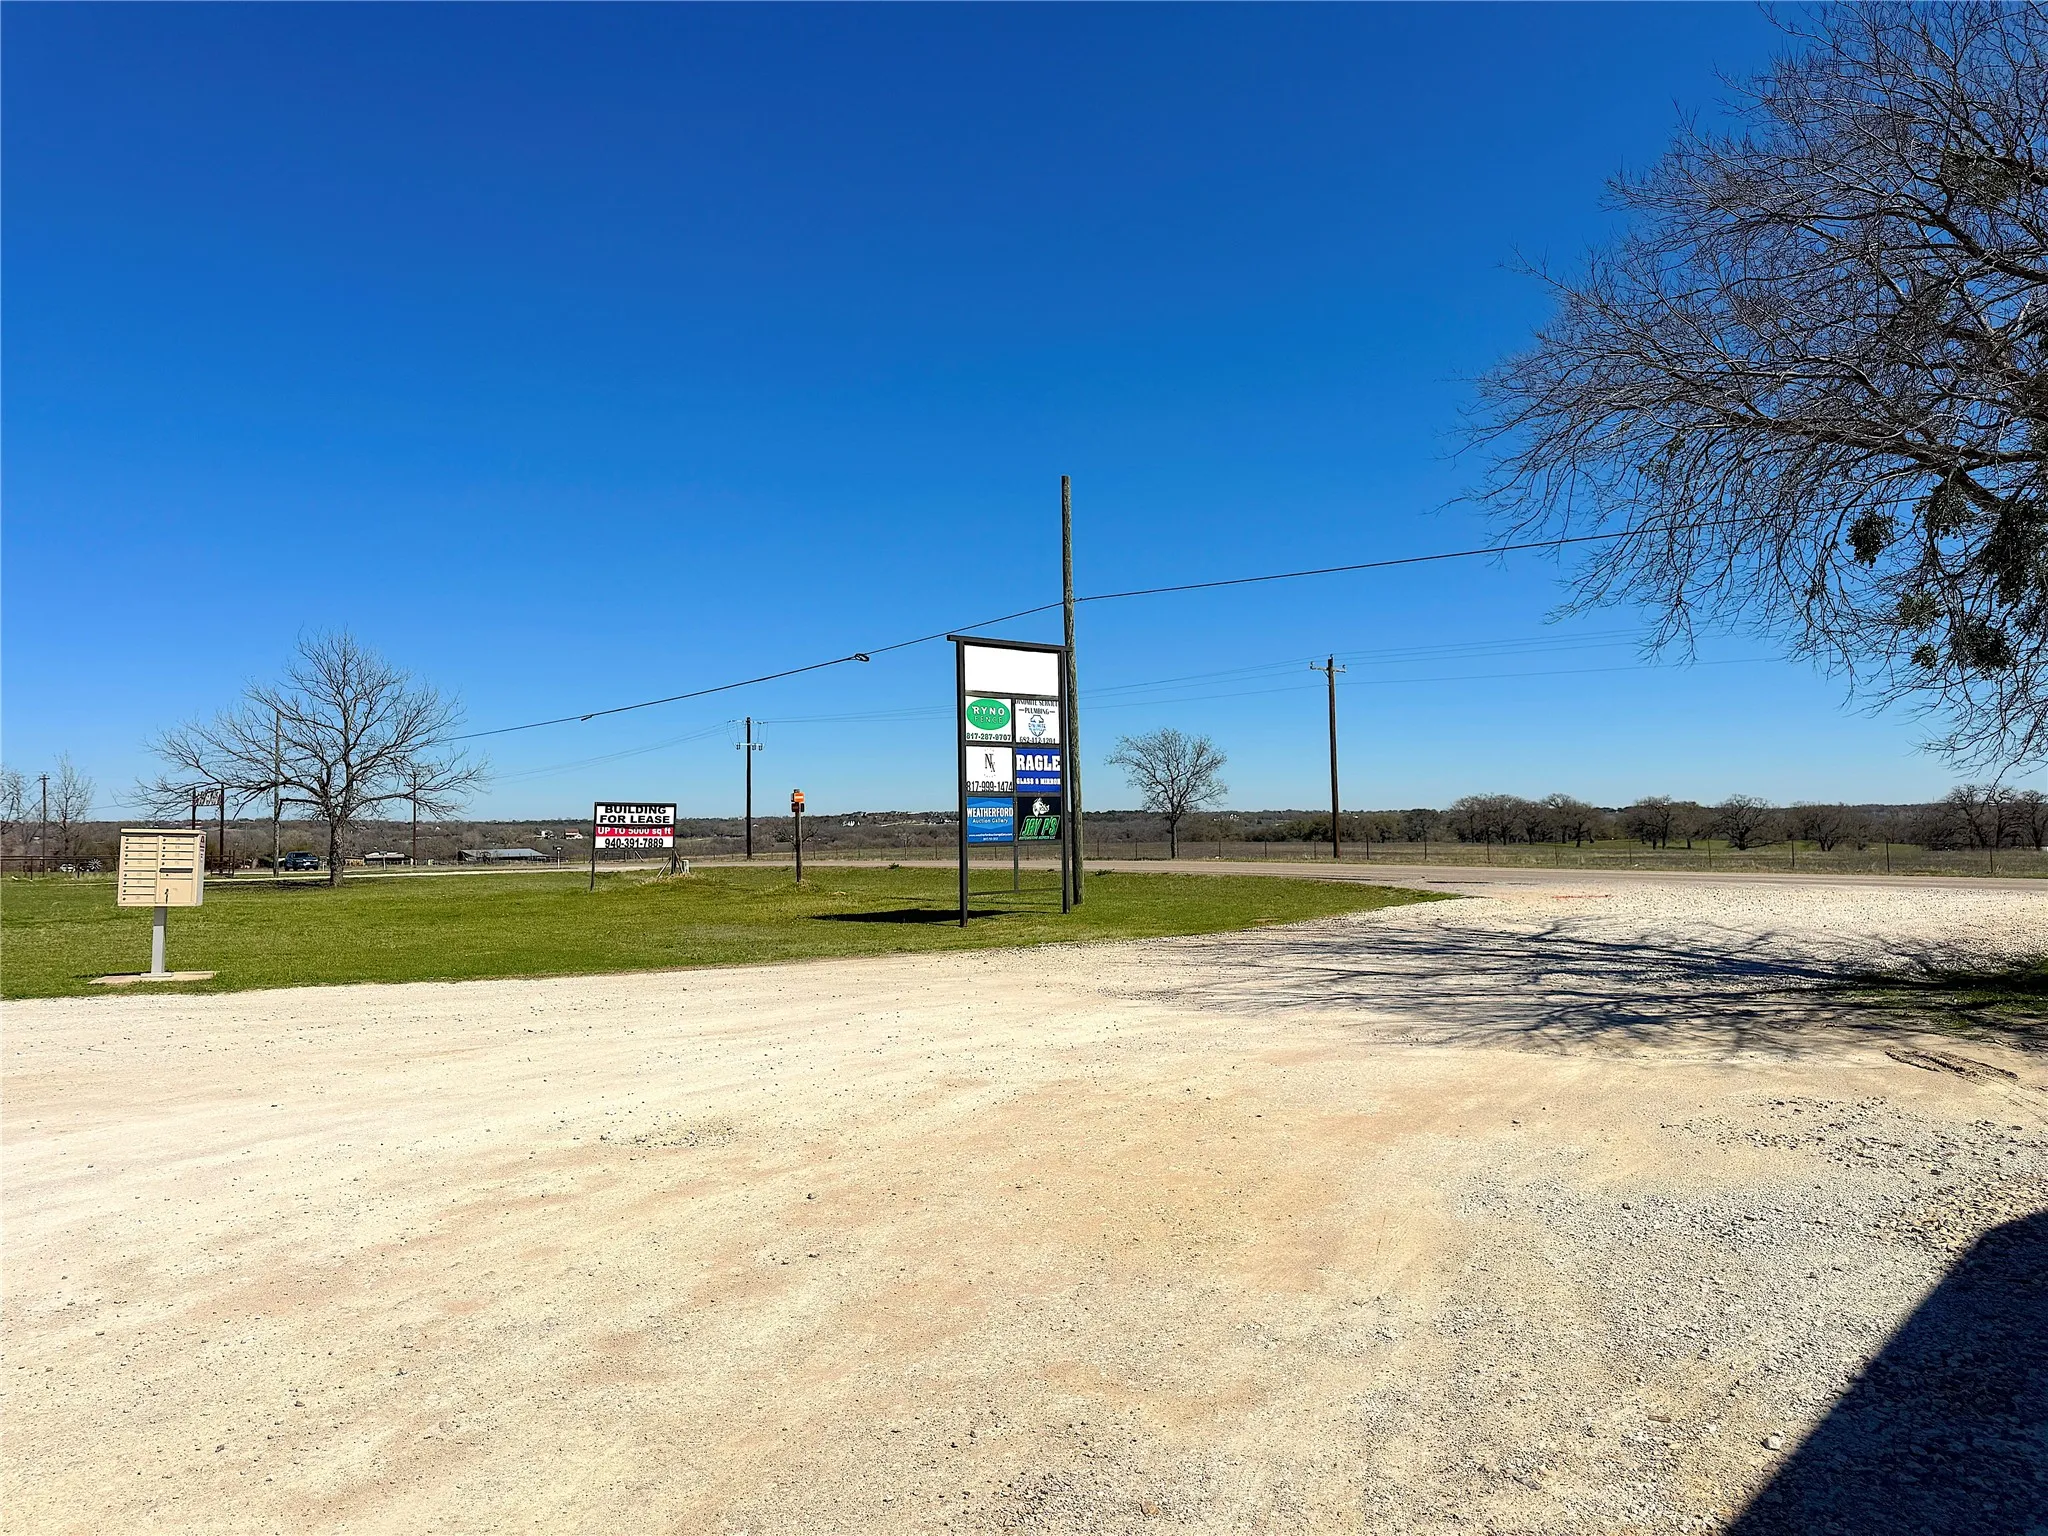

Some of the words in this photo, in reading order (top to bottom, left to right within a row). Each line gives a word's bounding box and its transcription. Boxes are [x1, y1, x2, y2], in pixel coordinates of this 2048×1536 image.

[972, 706, 1005, 716] RYNO
[1024, 707, 1050, 715] PLUMBING
[974, 716, 1003, 724] FENCE
[1015, 754, 1061, 771] RAGLE
[604, 805, 667, 814] BUILDING
[966, 807, 1013, 818] WEATHERFORD
[600, 815, 626, 824] FOR
[630, 815, 670, 824] LEASE
[598, 827, 611, 835] UP
[613, 827, 626, 835] TO
[652, 828, 663, 837] sq
[664, 827, 672, 835] ft
